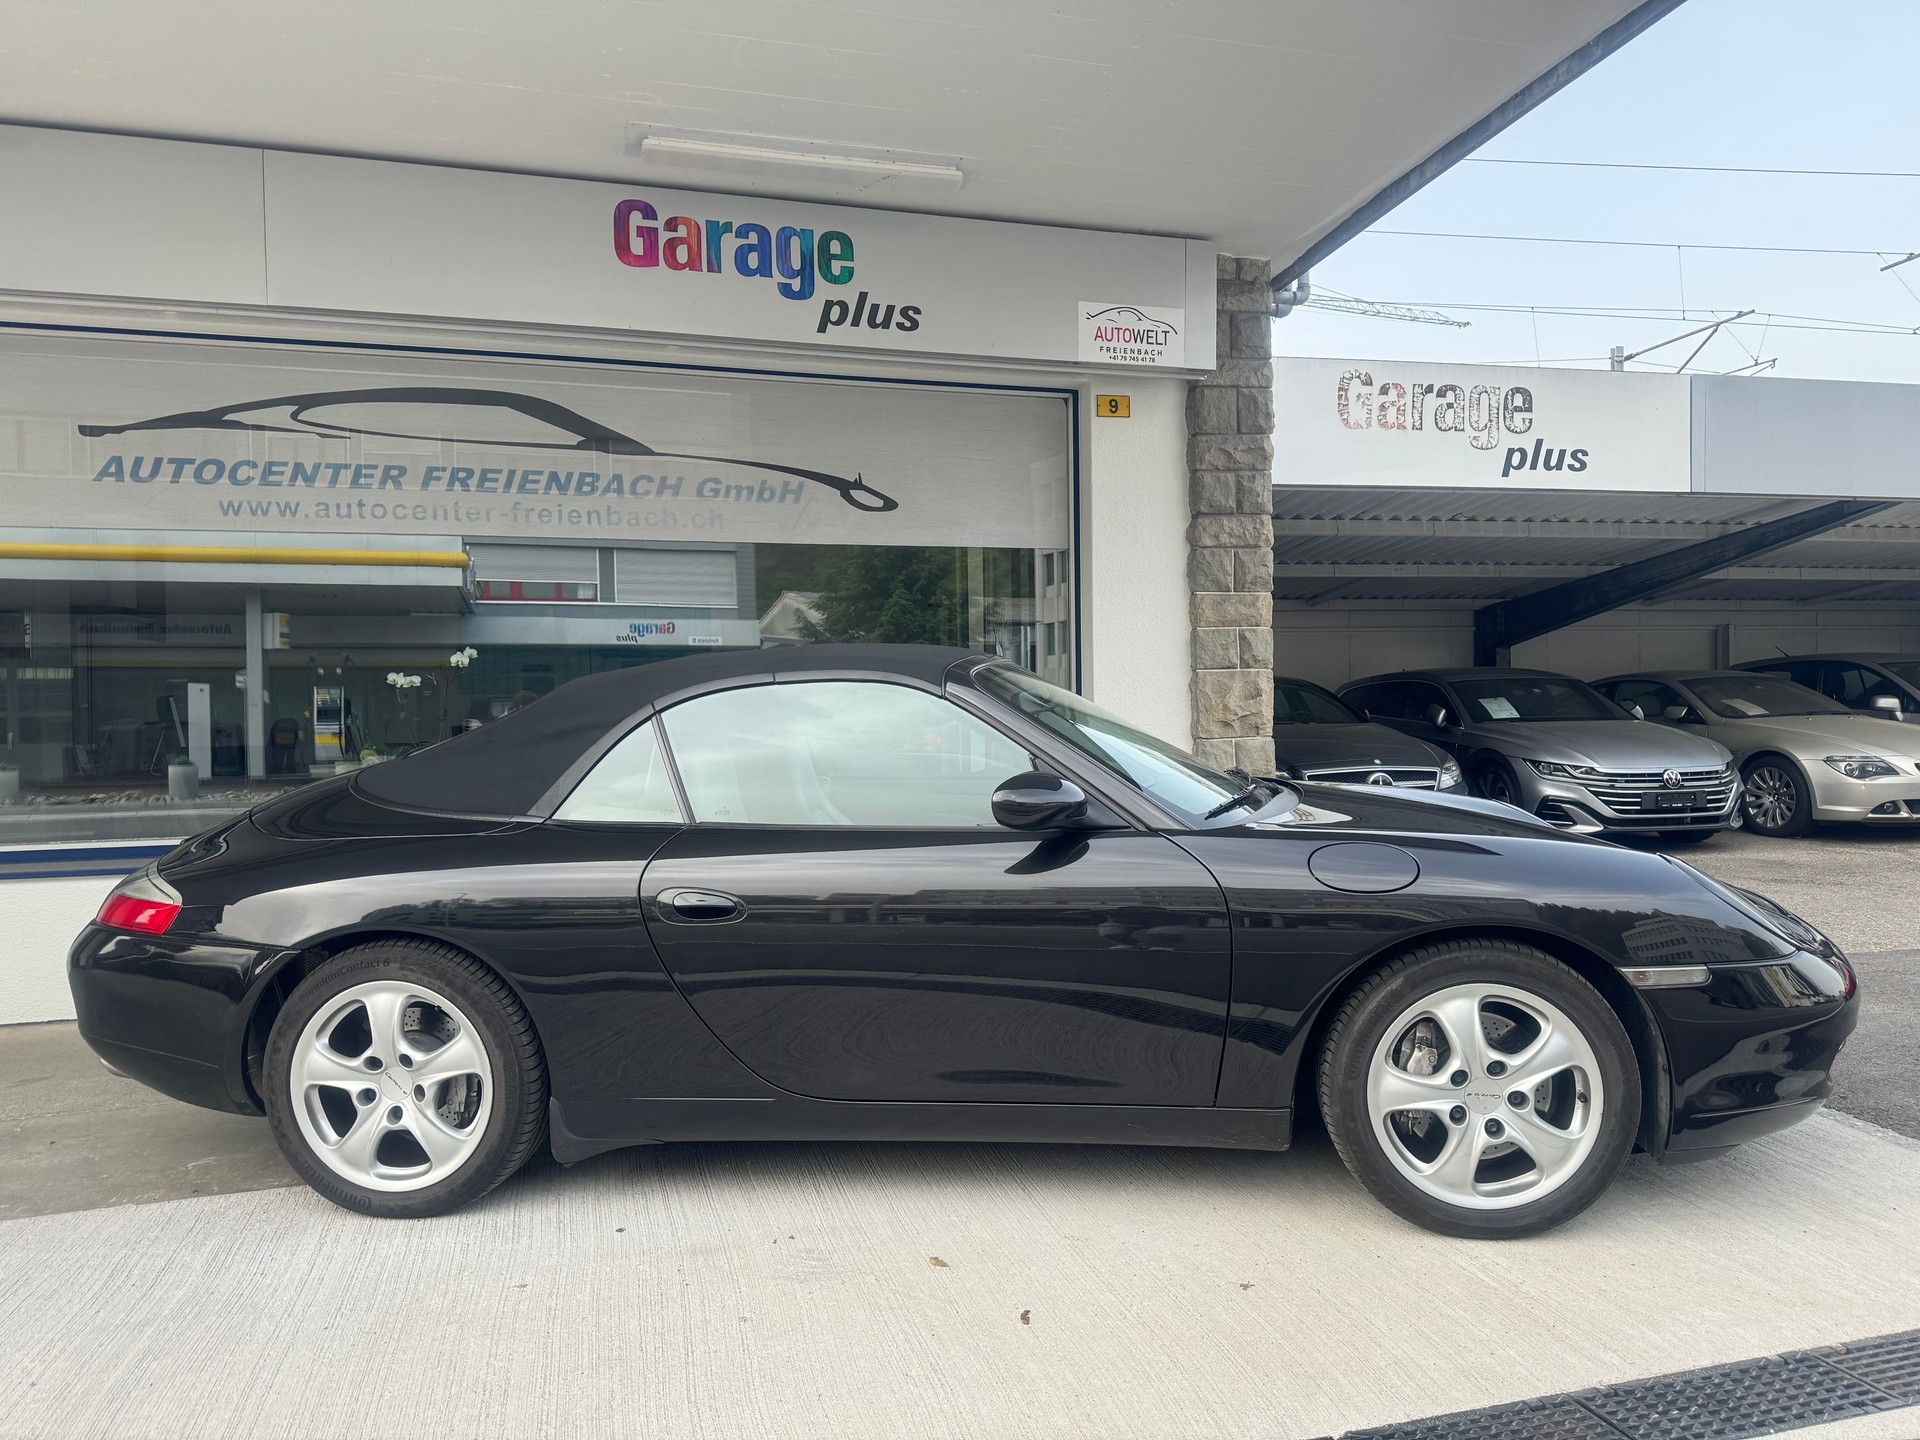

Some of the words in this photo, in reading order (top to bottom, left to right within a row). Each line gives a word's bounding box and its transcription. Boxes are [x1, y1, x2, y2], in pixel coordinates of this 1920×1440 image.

[613, 198, 855, 300] Garage
[816, 290, 922, 334] plus
[1094, 326, 1170, 346] AUTOWELT
[1099, 346, 1163, 356] FREIENBACH
[1109, 399, 1119, 414] 9
[1337, 368, 1534, 451] Garage
[1501, 439, 1589, 477] plus
[92, 455, 408, 491] AUTOCENTER
[420, 465, 691, 499] FREIENBACH
[695, 477, 805, 504] GmbH
[218, 498, 724, 530] www.autocenter-freienbach.ch
